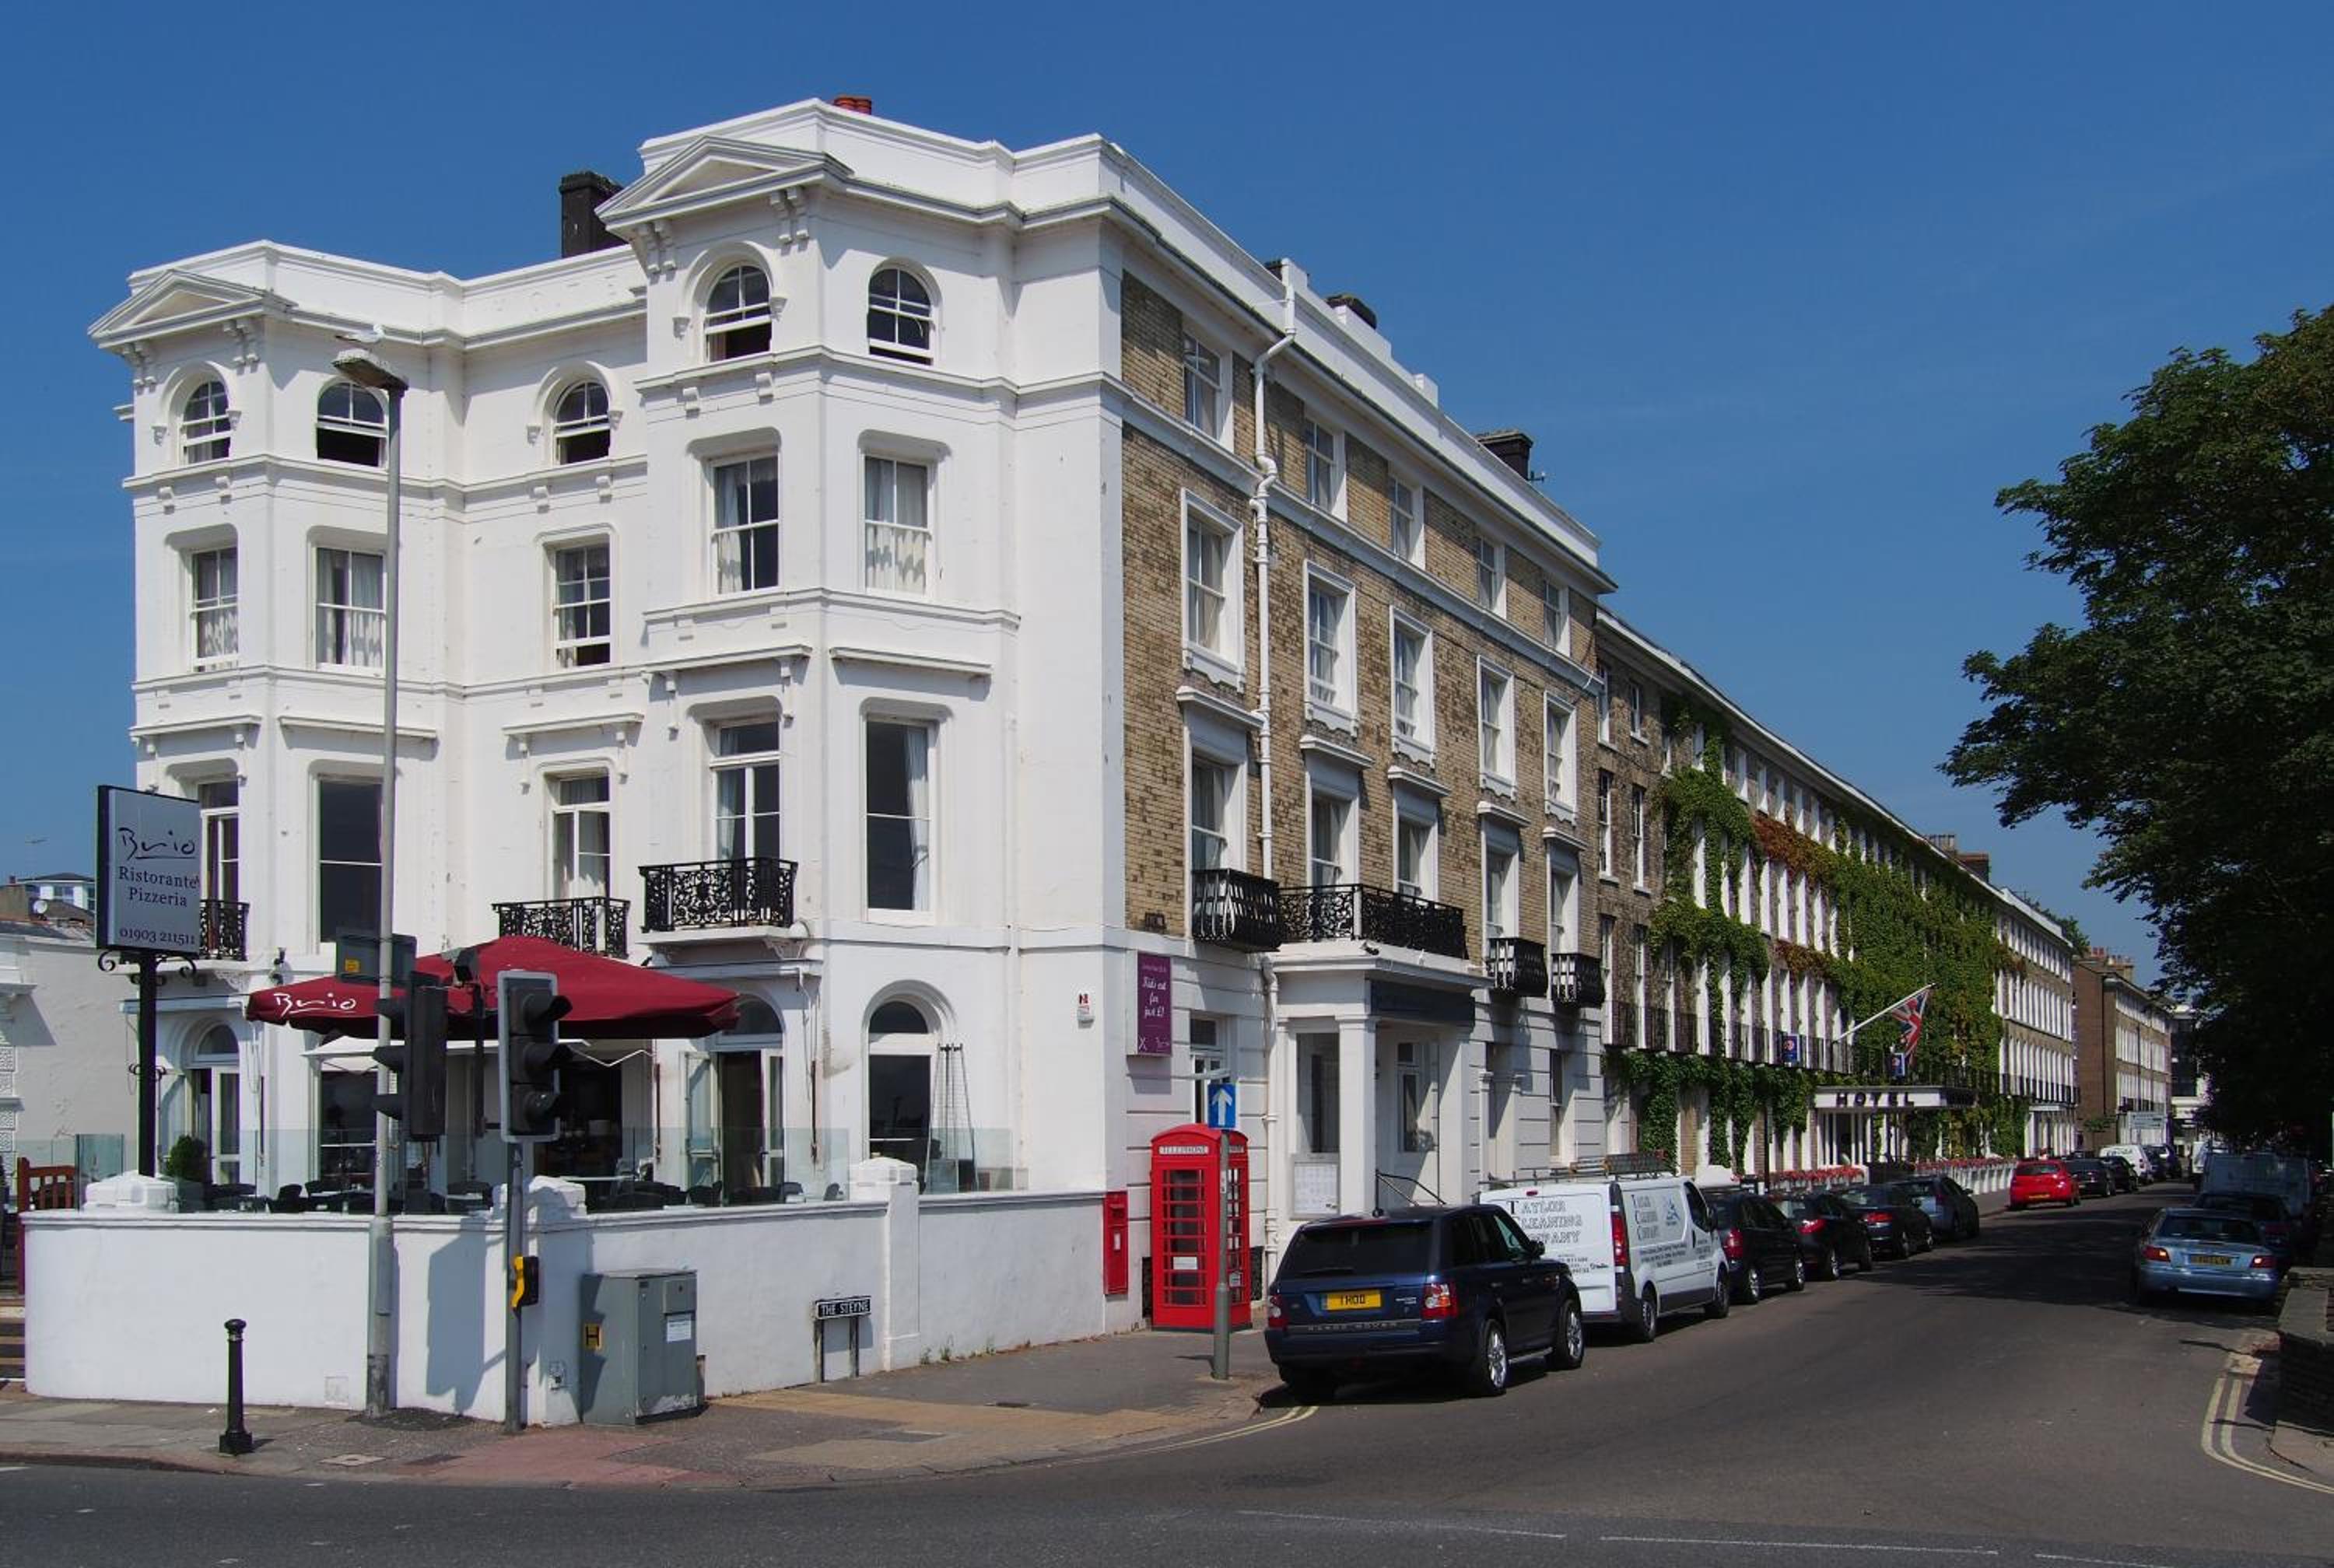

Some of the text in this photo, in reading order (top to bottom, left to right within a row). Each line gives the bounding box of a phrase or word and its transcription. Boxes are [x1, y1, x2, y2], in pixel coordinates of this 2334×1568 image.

[129, 887, 187, 908] Pizzeria
[120, 928, 156, 943] 01903
[1836, 1092, 1915, 1108] HOTEL
[1507, 1200, 1566, 1214] TAYLOR
[822, 1300, 869, 1315] THE STEYNE
[586, 1326, 599, 1346] H
